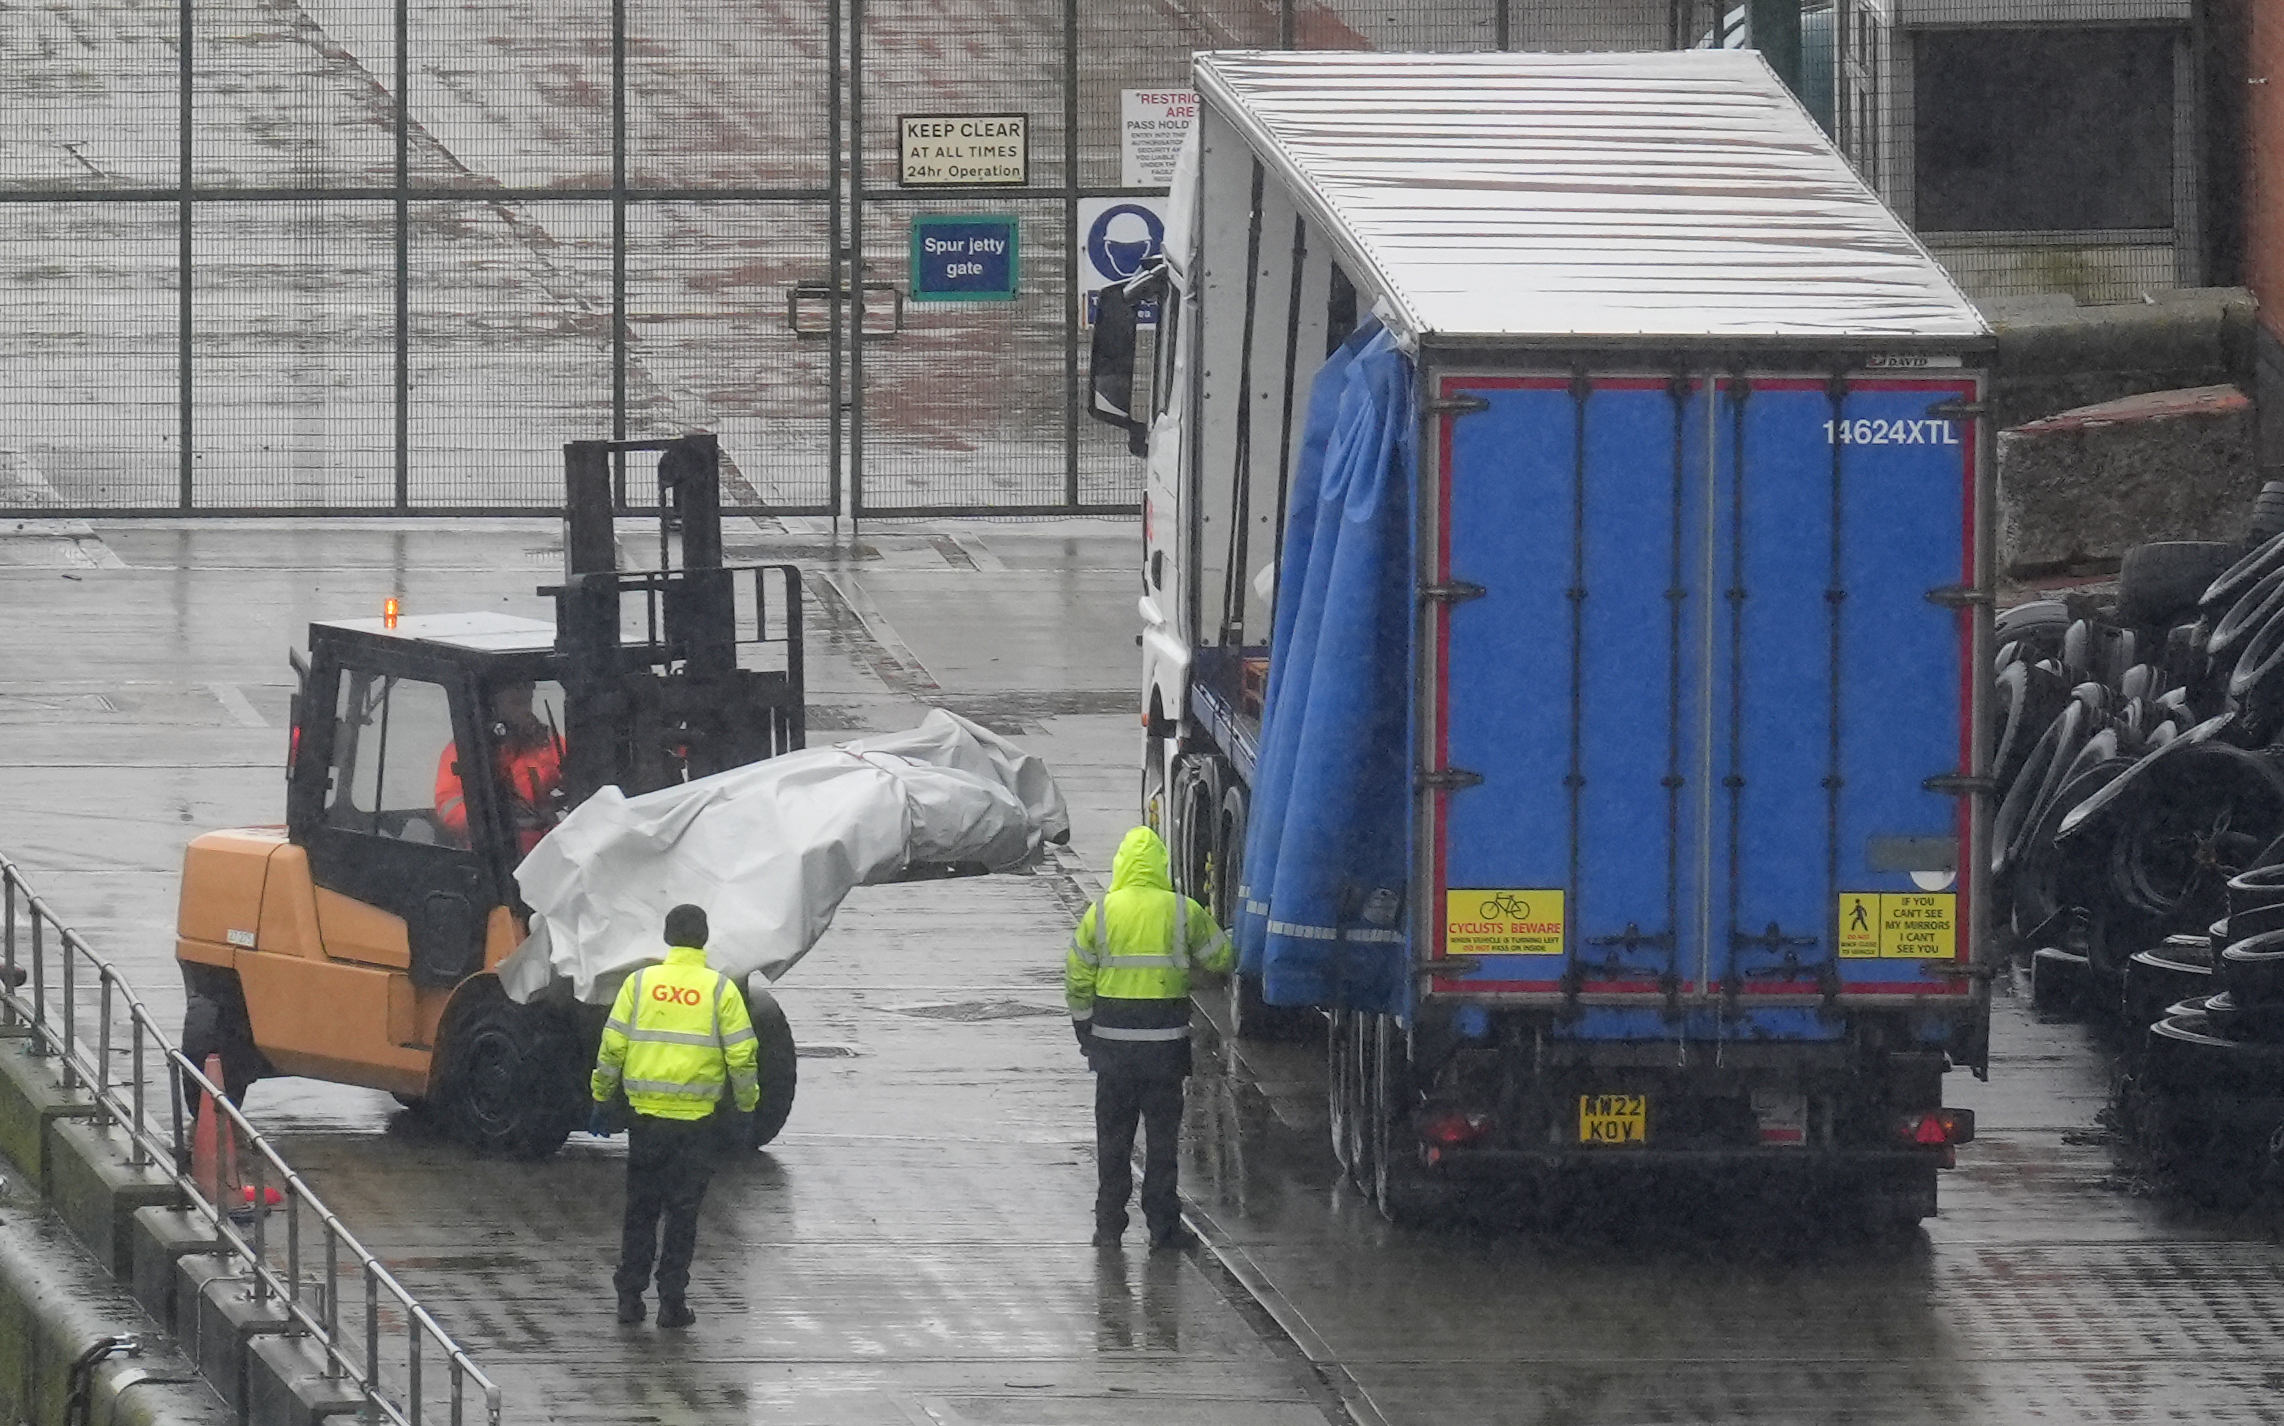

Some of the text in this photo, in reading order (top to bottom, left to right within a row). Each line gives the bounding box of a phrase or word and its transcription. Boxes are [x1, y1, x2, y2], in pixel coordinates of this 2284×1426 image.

[1166, 107, 1200, 117] ARE
[908, 123, 1021, 138] KEEP CLEAR
[1127, 121, 1191, 130] PASS HOLD
[911, 146, 1018, 158] AT ALL TIMES
[908, 165, 1021, 179] 24hr Operation
[924, 237, 1006, 255] Spur jetty
[946, 261, 984, 279] gate
[1822, 419, 1960, 445] 14624XTL
[1901, 897, 1935, 906] IF YOU
[1925, 909, 1943, 918] SEE
[1449, 923, 1561, 934] CYCLISTS BEWARE
[1885, 921, 1951, 930] MY MIRRORS
[1900, 933, 1903, 942] I
[1896, 945, 1939, 954] SEE YOU
[652, 984, 701, 1006] GXO
[1590, 1121, 1633, 1141] KOV
